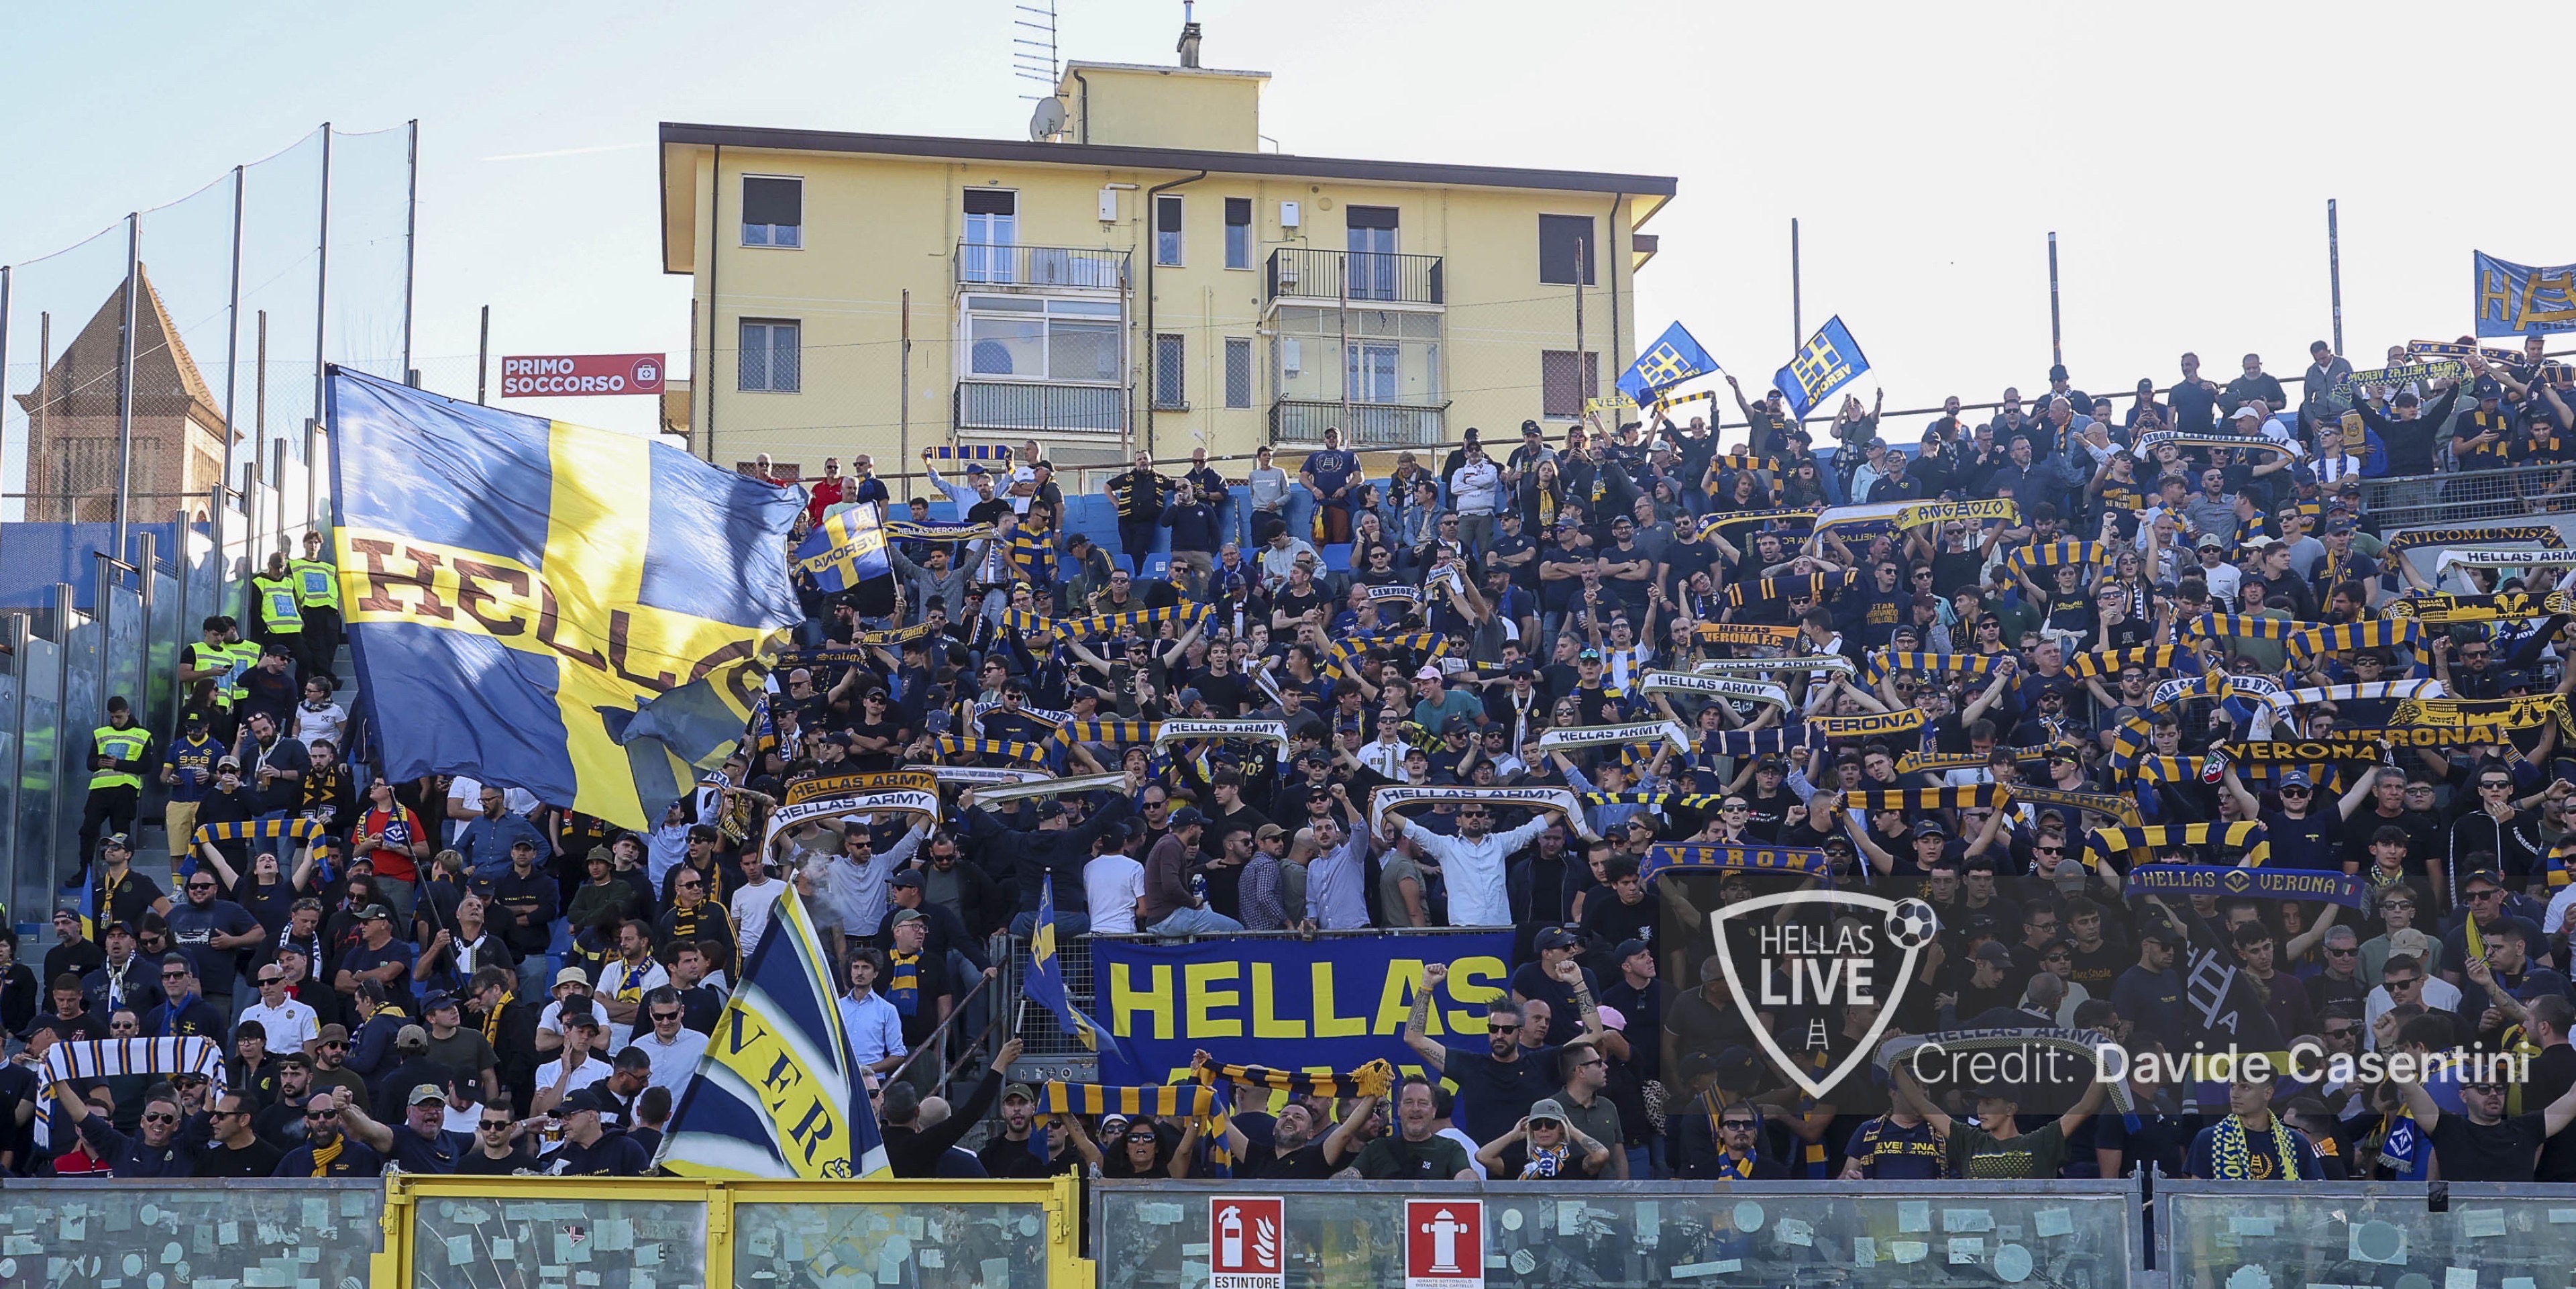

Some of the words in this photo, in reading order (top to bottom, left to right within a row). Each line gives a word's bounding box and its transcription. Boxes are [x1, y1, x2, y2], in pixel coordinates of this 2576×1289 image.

[504, 358, 574, 375] PRIMO
[504, 376, 625, 393] SOCCORSO
[1597, 397, 1636, 407] VERO
[930, 526, 965, 534] VERONA
[968, 525, 979, 533] FC
[2467, 552, 2533, 562] HELLAS
[2539, 551, 2576, 562] ARM
[1719, 625, 1770, 633] HELLAS
[1702, 632, 1759, 644] VERONA
[1762, 634, 1783, 648] F.C.
[1658, 674, 1716, 690] HELLAS
[1721, 681, 1766, 695] ARMY
[1169, 723, 1228, 733] HELLAS
[1233, 723, 1279, 734] ARMY
[1559, 731, 1613, 741] HELLAS
[1619, 724, 1664, 737] ARMY
[1904, 753, 1988, 768] HELLAS
[2016, 742, 2061, 757] RMY
[2223, 741, 2377, 760] VERONA
[792, 776, 863, 798] HELLAS
[871, 772, 931, 788] ARMY
[1385, 789, 1477, 802] HELLAS
[1484, 789, 1563, 801] ARMY
[775, 797, 857, 823] HELLAS
[866, 790, 929, 805] ARMY
[2143, 870, 2216, 887] HELLAS
[2259, 874, 2336, 894] VERONA
[1110, 956, 1508, 1039] HELLAS
[1925, 1027, 2022, 1043] HELLAS
[1884, 1141, 1935, 1151] VEONA
[1215, 1277, 1280, 1289] ESTINTORE
